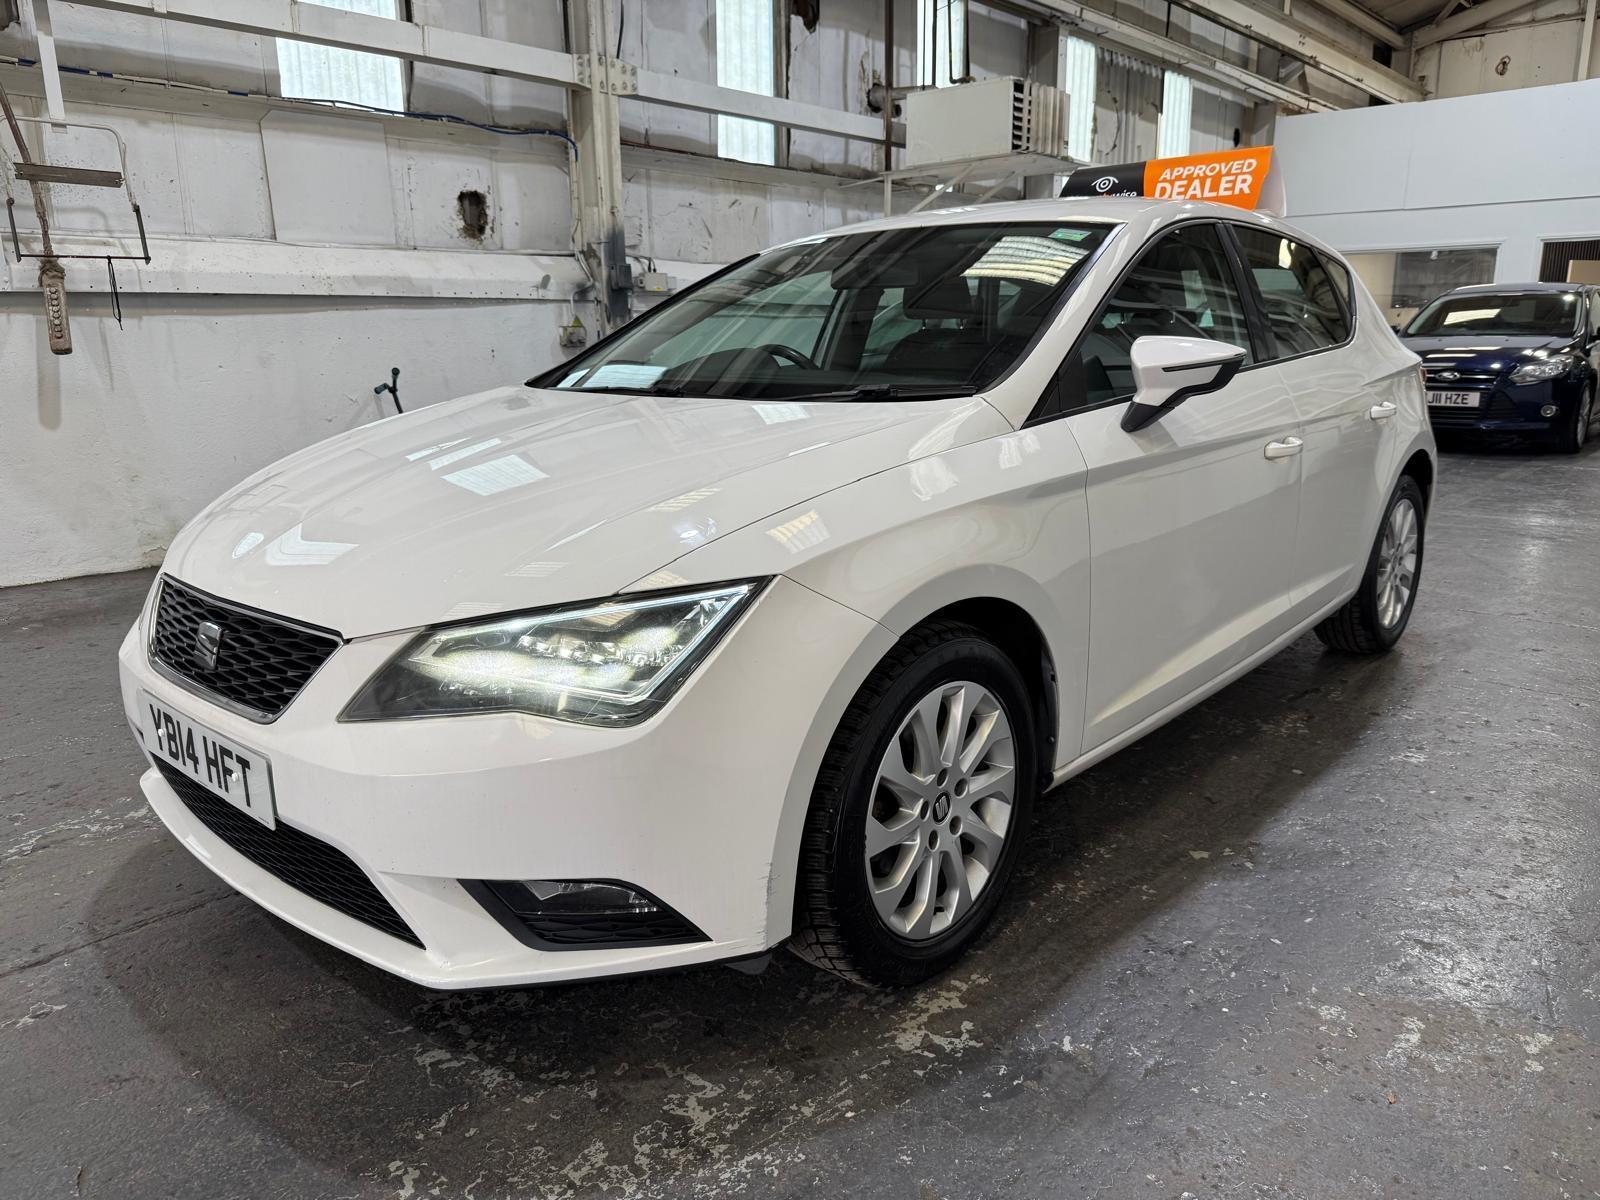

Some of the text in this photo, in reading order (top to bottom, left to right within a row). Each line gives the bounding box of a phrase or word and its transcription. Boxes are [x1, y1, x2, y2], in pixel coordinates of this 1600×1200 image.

[1159, 158, 1257, 181] APPROVED
[1154, 174, 1253, 200] DEALER
[1444, 392, 1469, 405] HZE
[149, 703, 251, 808] YB14 HFT
